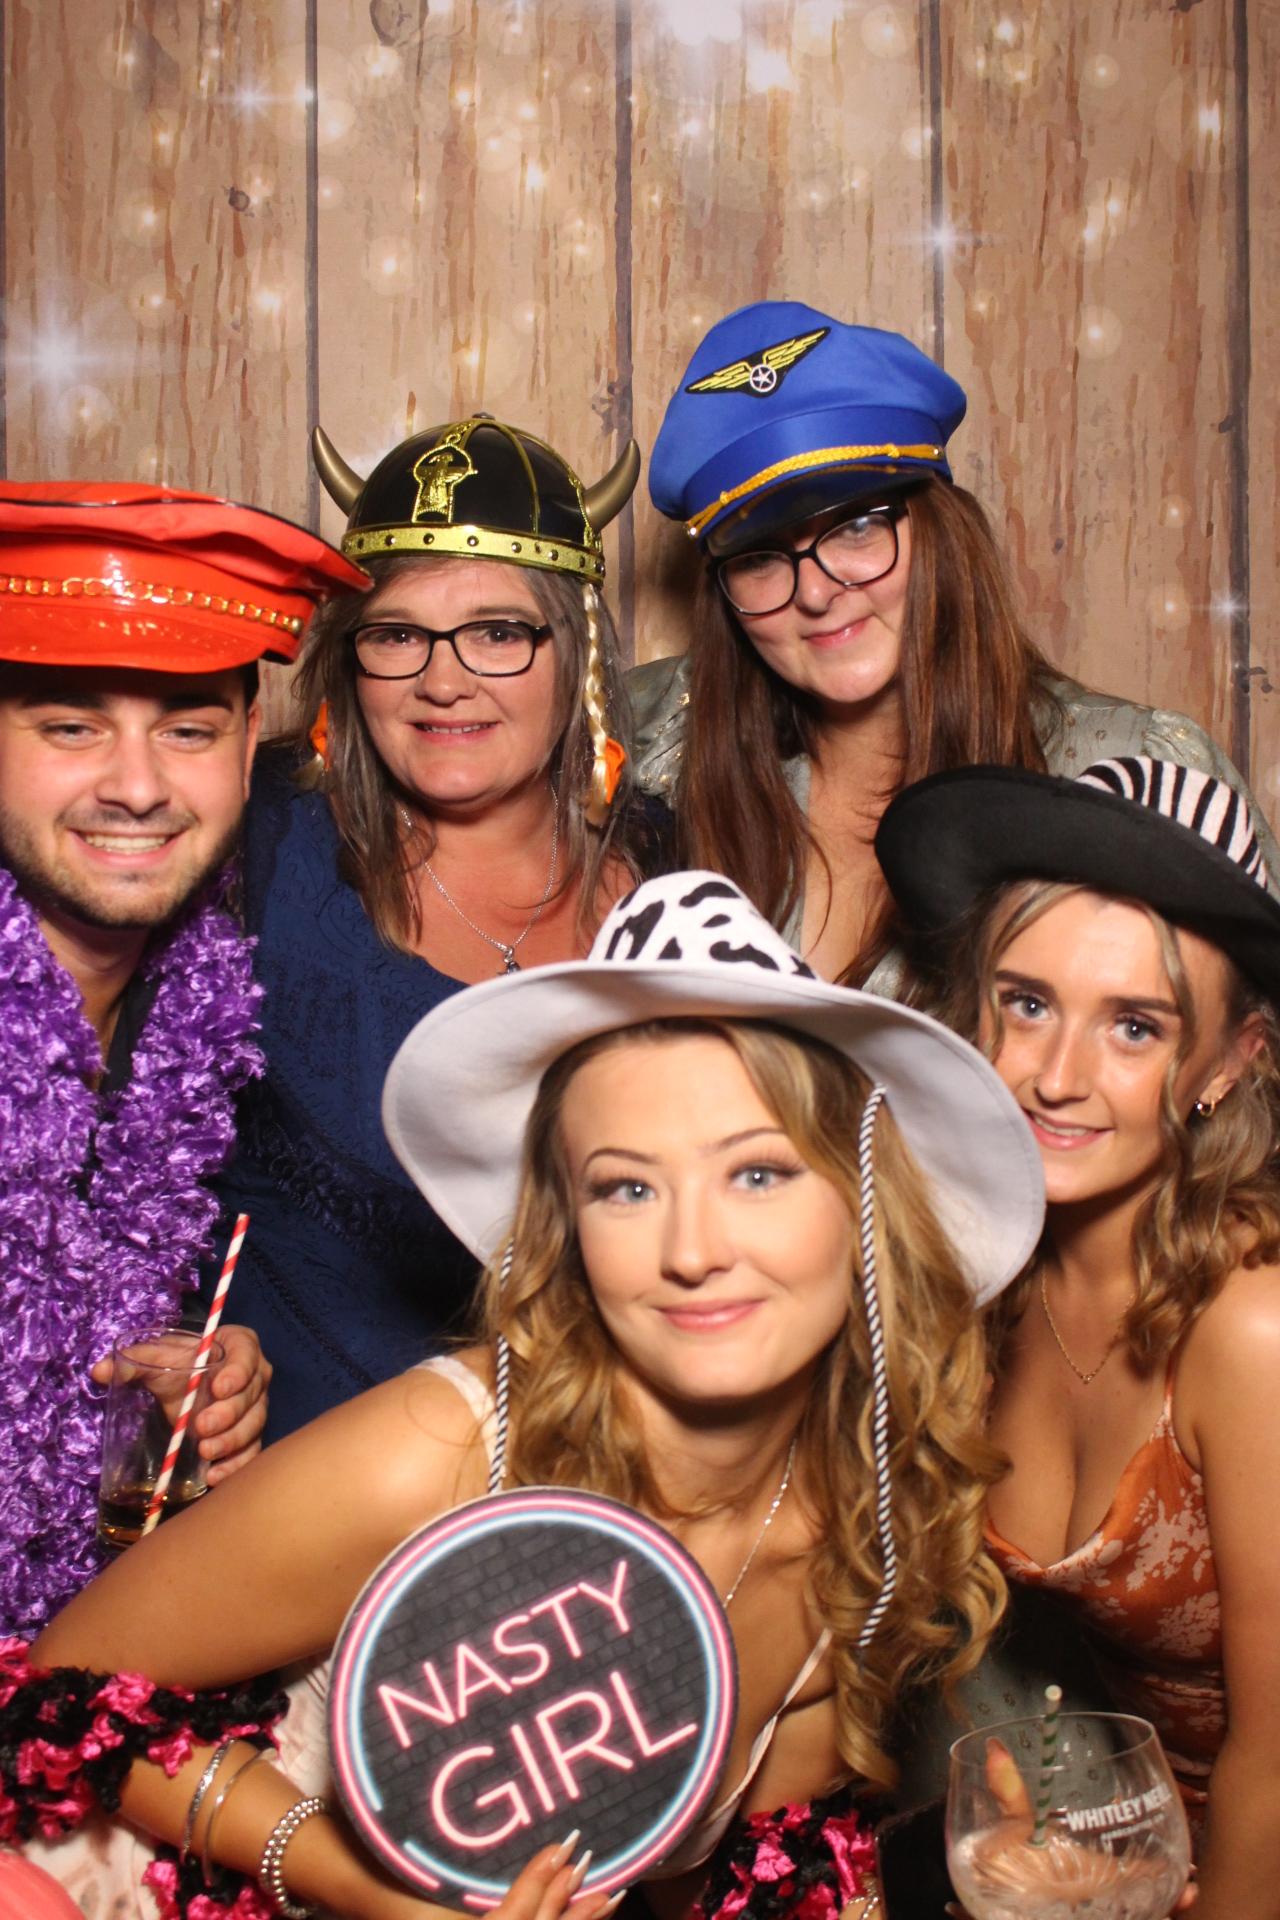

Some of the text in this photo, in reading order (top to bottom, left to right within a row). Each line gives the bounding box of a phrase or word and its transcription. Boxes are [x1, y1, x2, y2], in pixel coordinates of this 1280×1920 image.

[377, 1560, 630, 1749] NASTY
[431, 1671, 698, 1849] GIRL
[1066, 1797, 1143, 1832] WHITLEY
